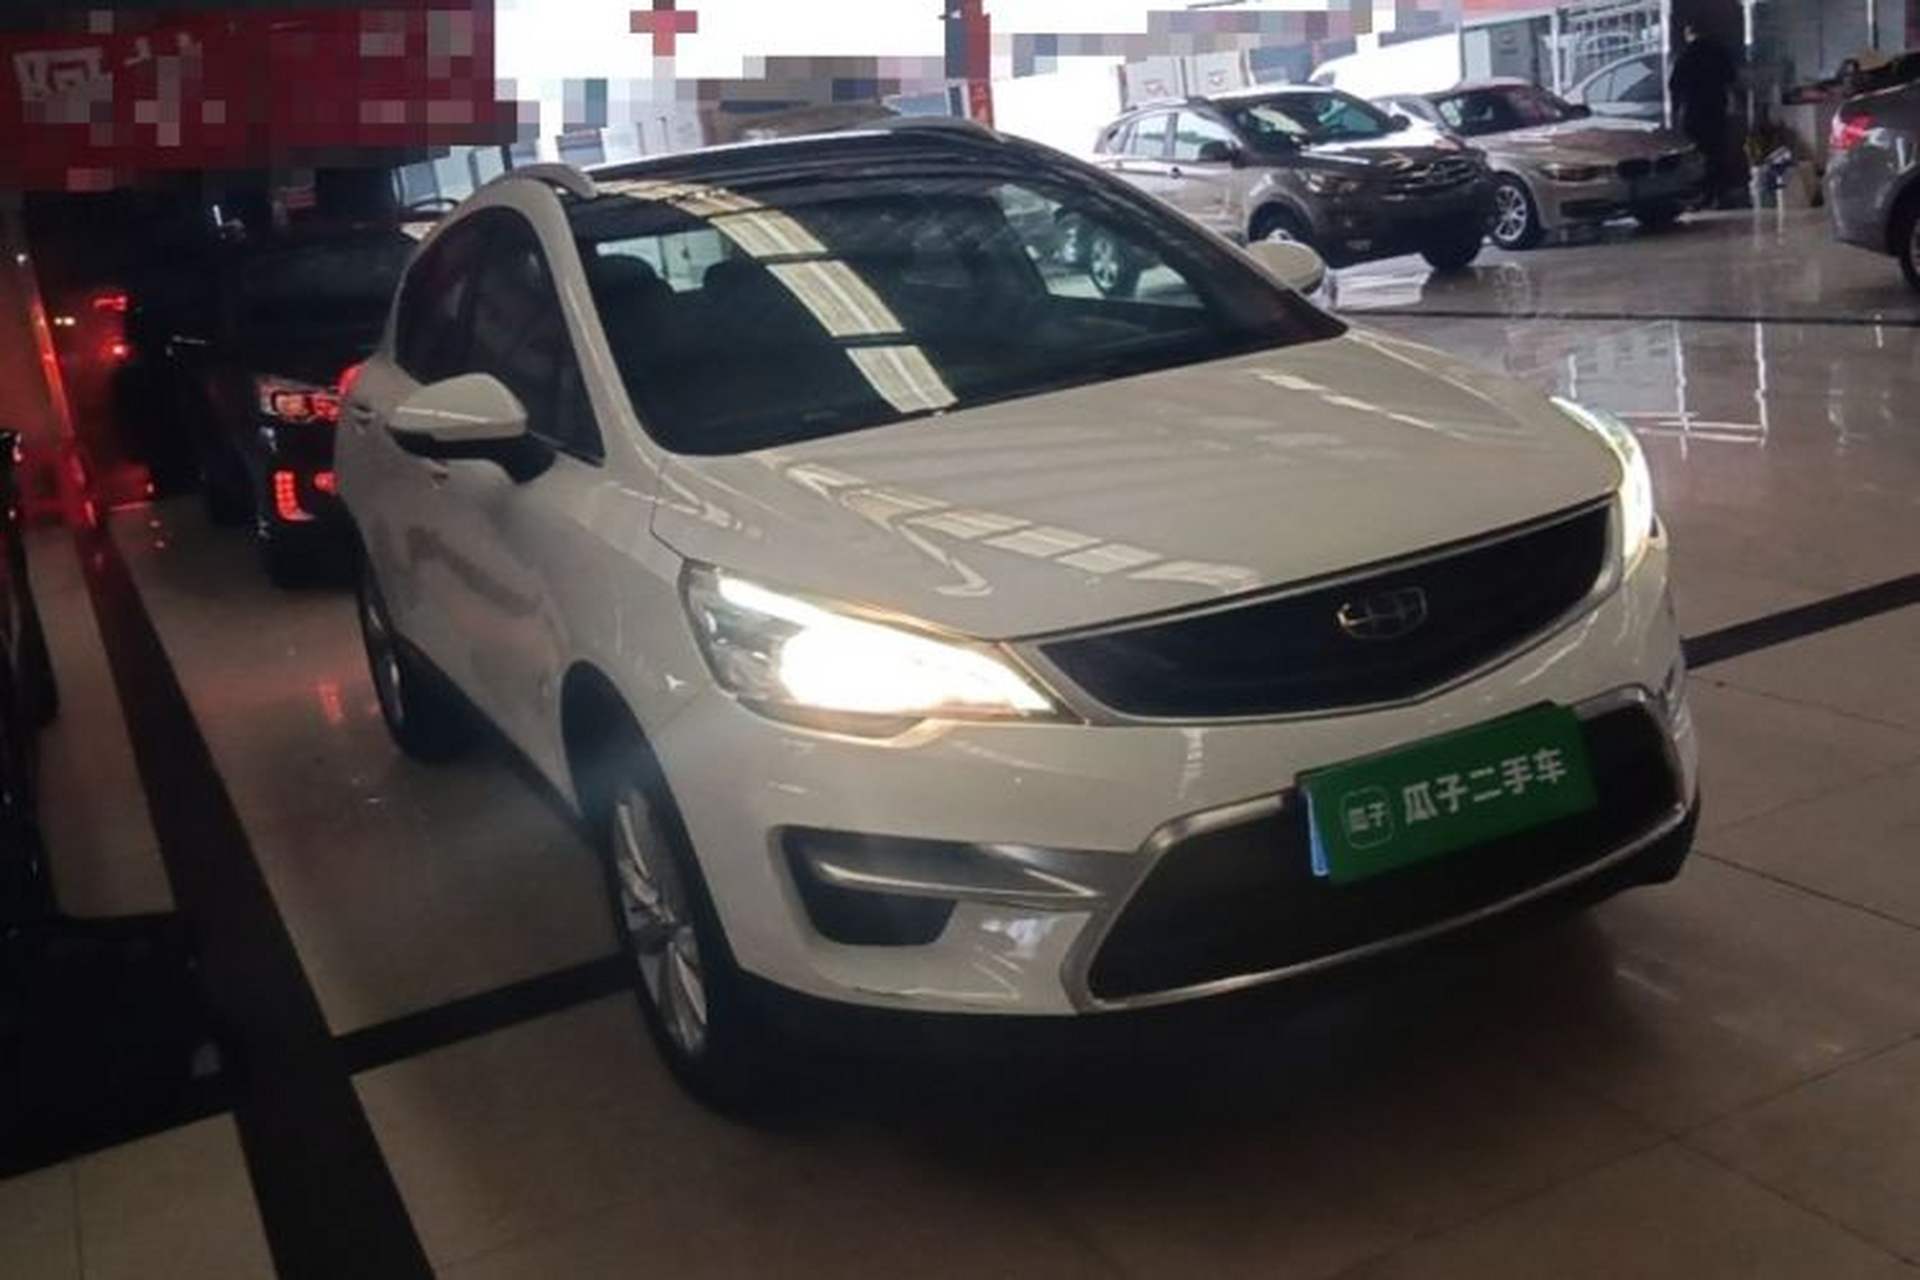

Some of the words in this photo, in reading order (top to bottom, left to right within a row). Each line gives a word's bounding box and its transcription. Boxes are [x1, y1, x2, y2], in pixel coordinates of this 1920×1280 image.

[1403, 748, 1567, 825] 瓜子二手车
